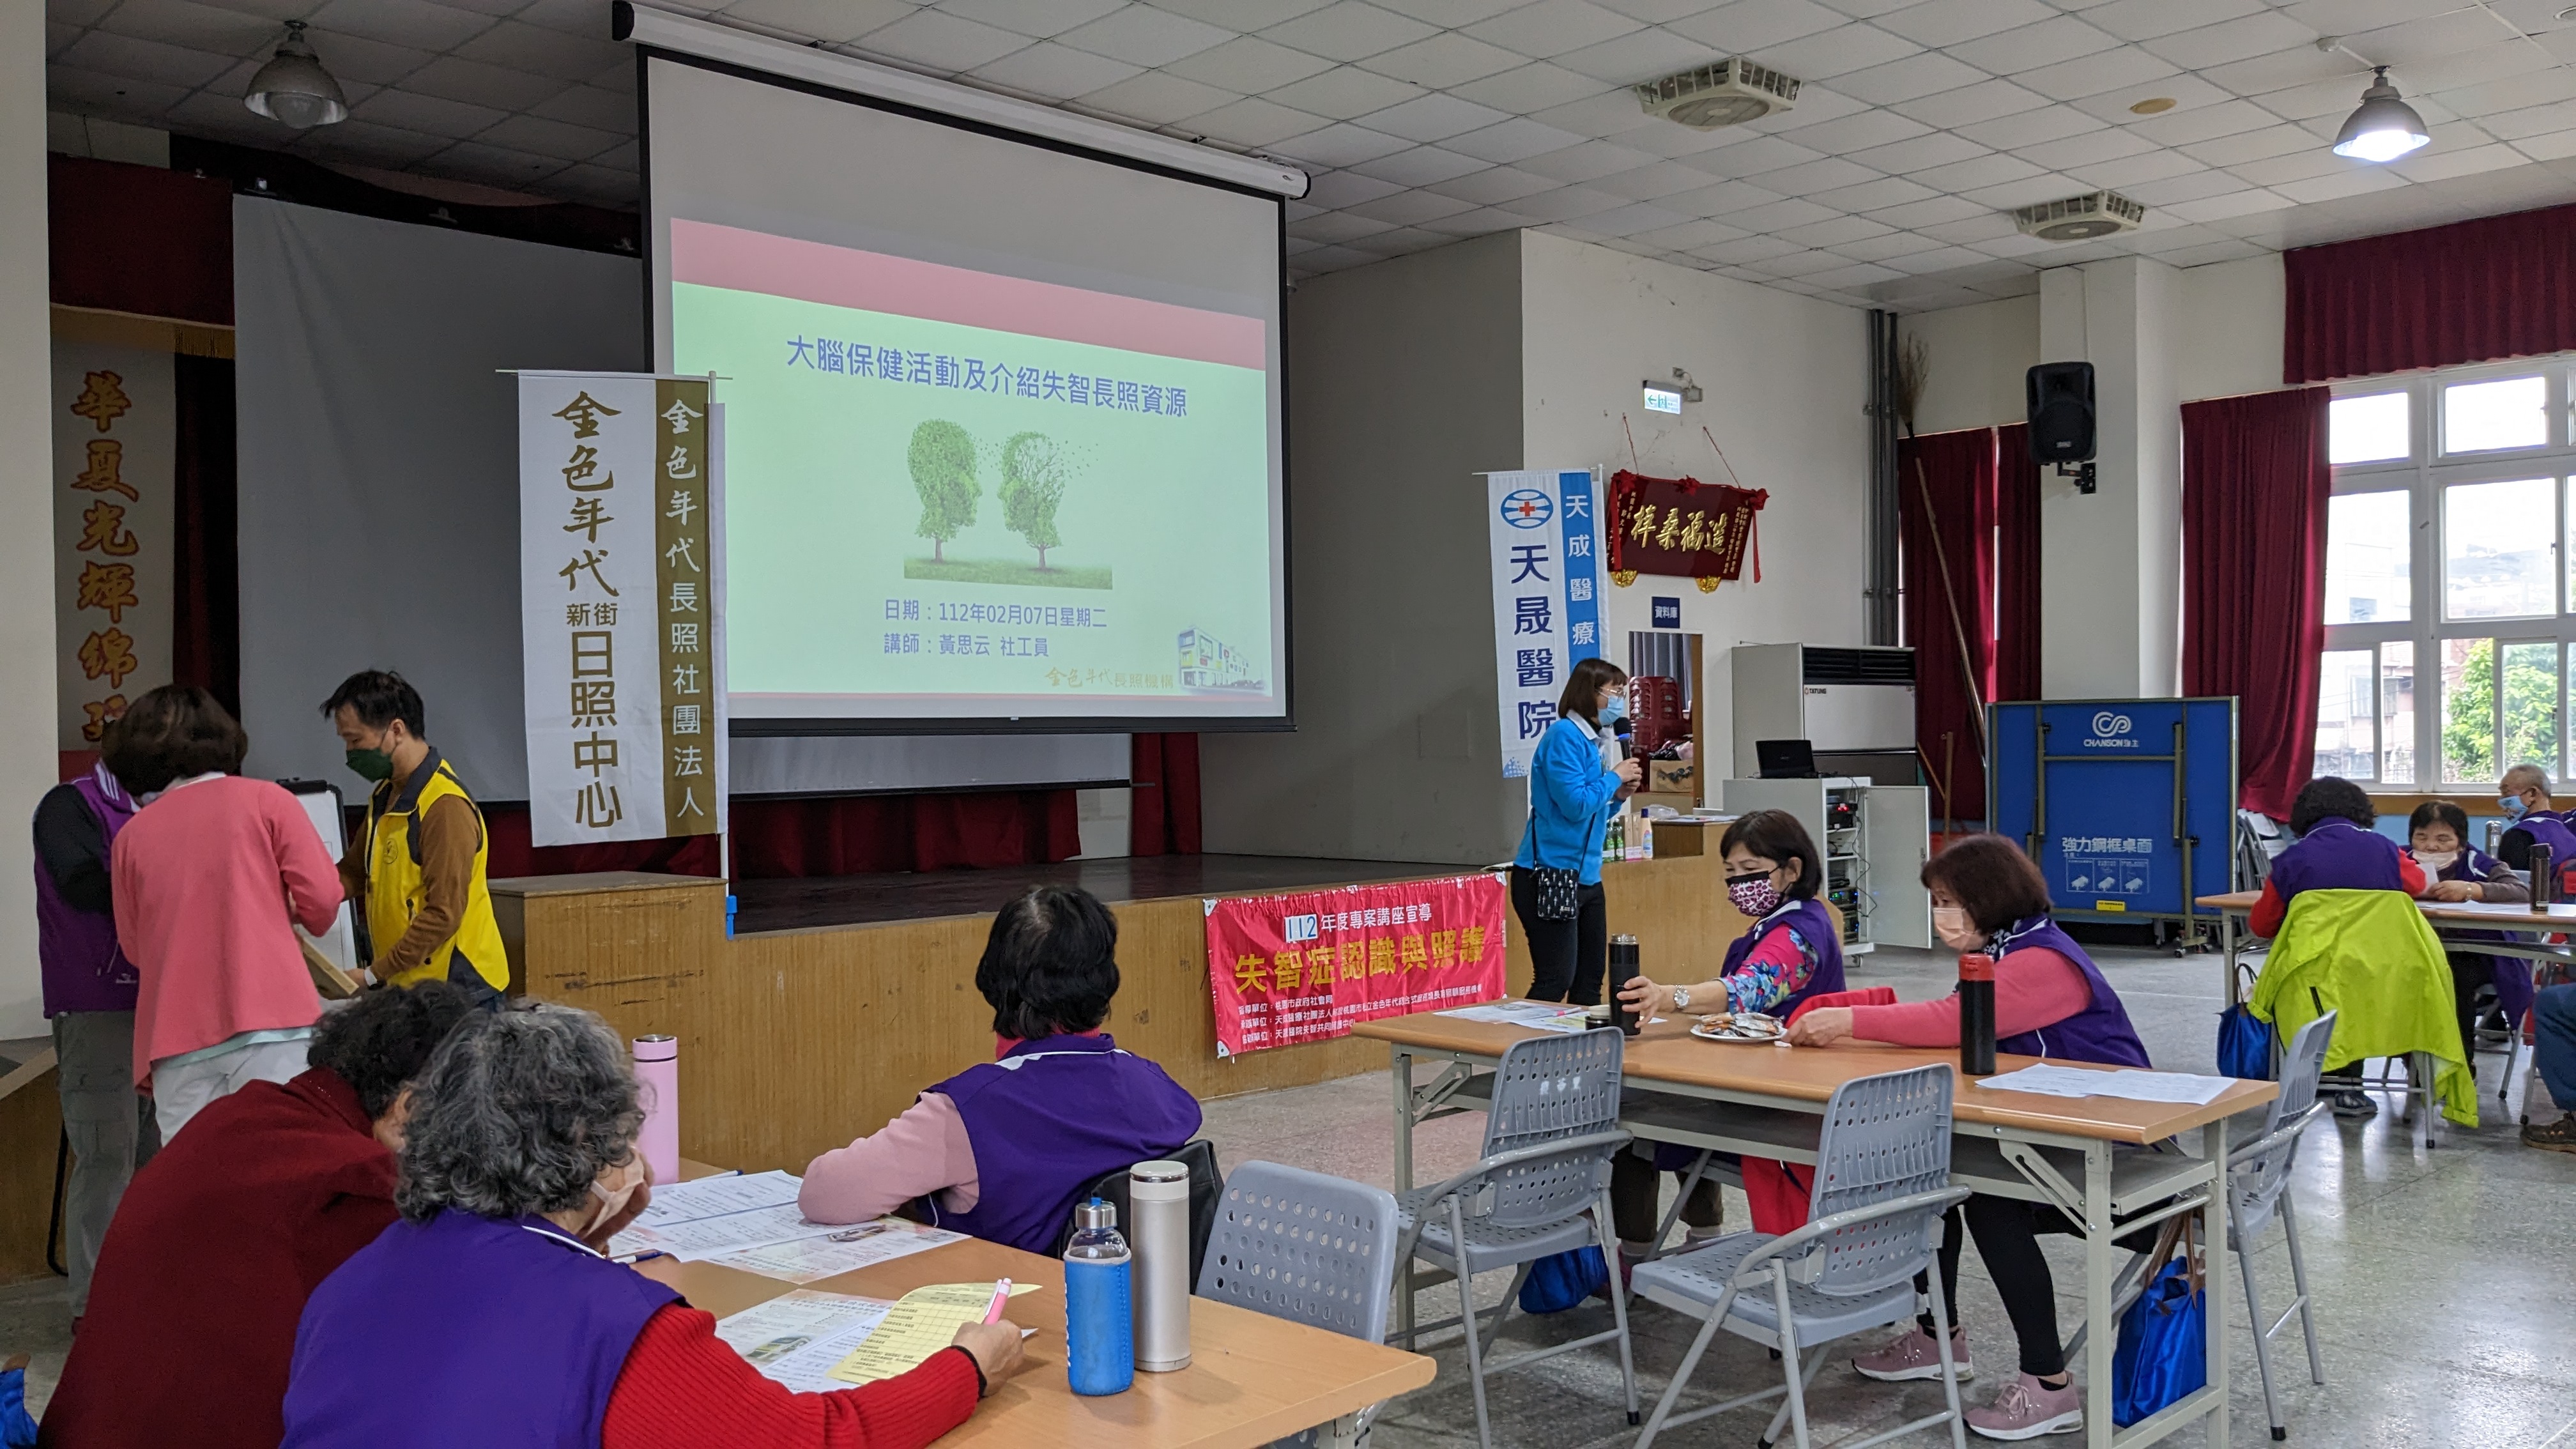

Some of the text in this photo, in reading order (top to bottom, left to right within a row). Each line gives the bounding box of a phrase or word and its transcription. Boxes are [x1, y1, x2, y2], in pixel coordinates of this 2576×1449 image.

[786, 334, 1188, 418] 大腦保健活動及介紹失智長照資源
[551, 390, 622, 597] 金色年代
[1565, 494, 1595, 645] 天成醫療
[565, 602, 618, 628] 新街
[661, 399, 705, 819] 金色年代長照社團法人
[885, 599, 1107, 628] 日期：112年02月07日星期二
[1000, 636, 1050, 657] 社工員
[1509, 544, 1557, 740] 天晟醫院
[1045, 666, 1174, 689] 金色年代長照機構
[570, 630, 624, 829] 日照中心
[2083, 739, 2123, 747] CHANSON
[1234, 926, 1486, 994] 失智症認識與照護
